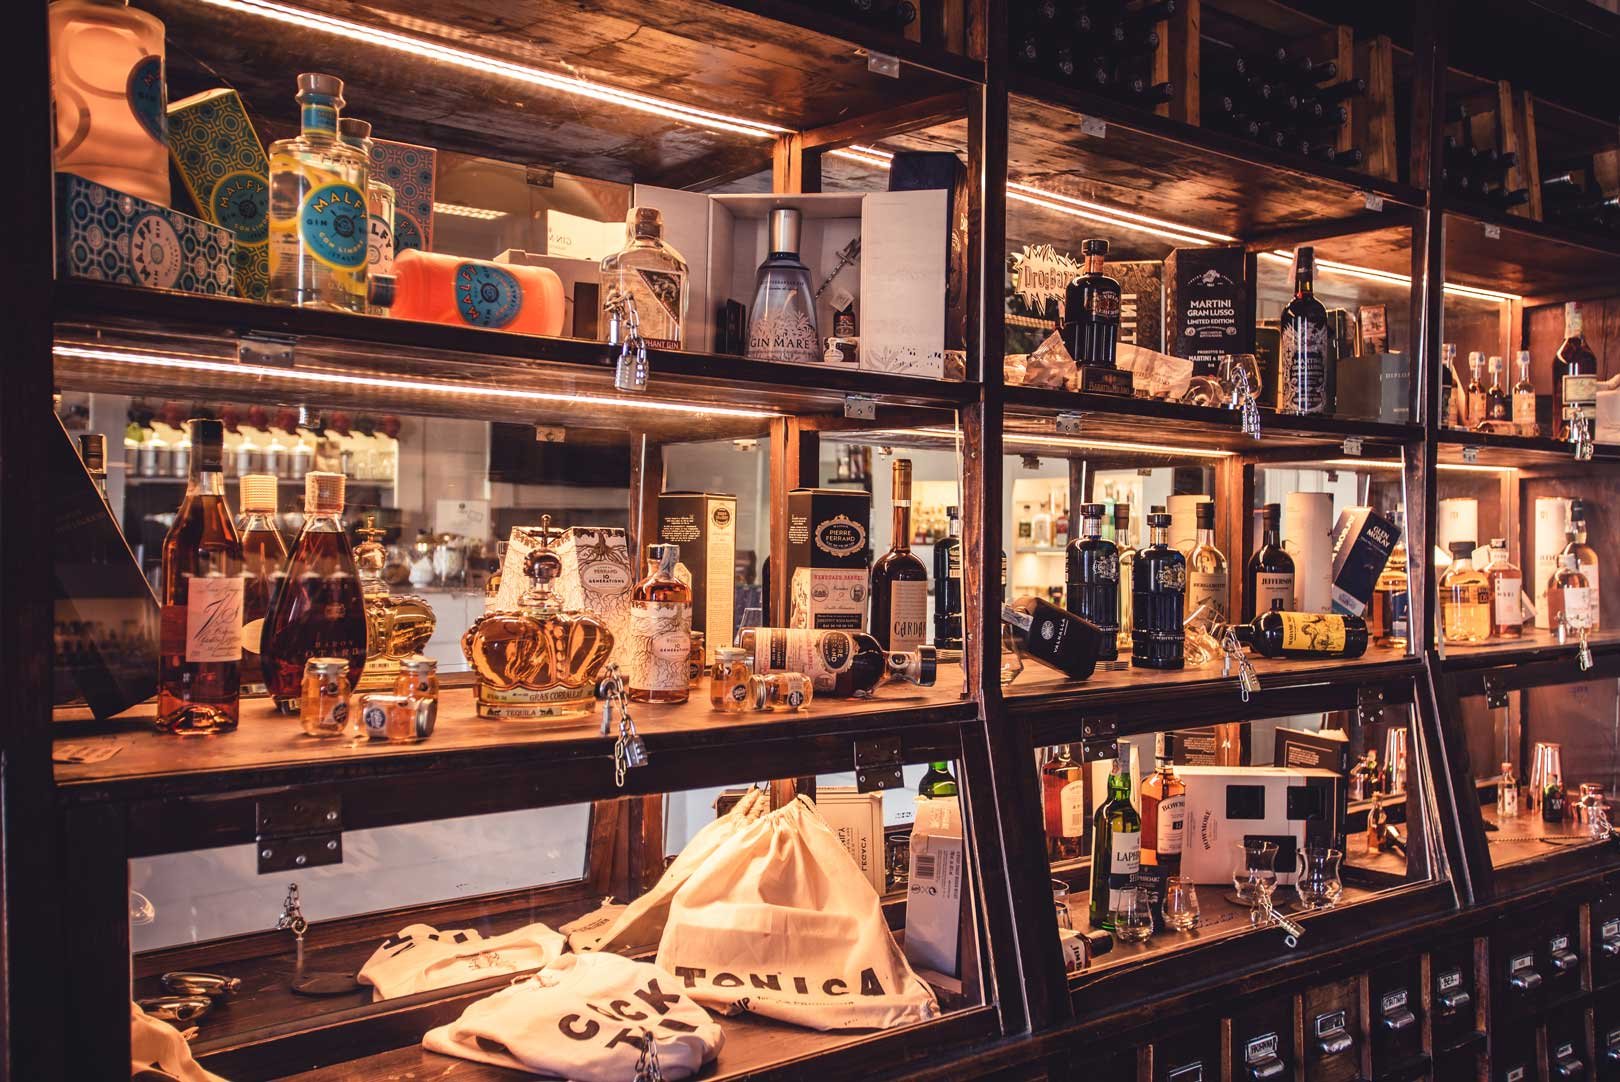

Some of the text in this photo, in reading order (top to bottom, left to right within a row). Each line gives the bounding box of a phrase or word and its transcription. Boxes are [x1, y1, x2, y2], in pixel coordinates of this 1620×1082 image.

[220, 180, 264, 208] MALFY
[312, 191, 367, 213] MALFY
[135, 220, 151, 281] MALFY
[460, 265, 480, 318] MALFY
[1190, 300, 1232, 309] MARTINI
[1187, 309, 1209, 317] GRAN
[667, 341, 680, 349] GIN
[750, 339, 810, 350] GIN MARE
[1333, 515, 1354, 552] MORAY
[1366, 529, 1391, 549] MORAY
[1372, 525, 1390, 540] GLEN
[1053, 618, 1066, 653] VALHALLA
[1200, 810, 1211, 850] BOWMORE
[675, 966, 886, 996] TONICA
[558, 978, 680, 1040] CCK
